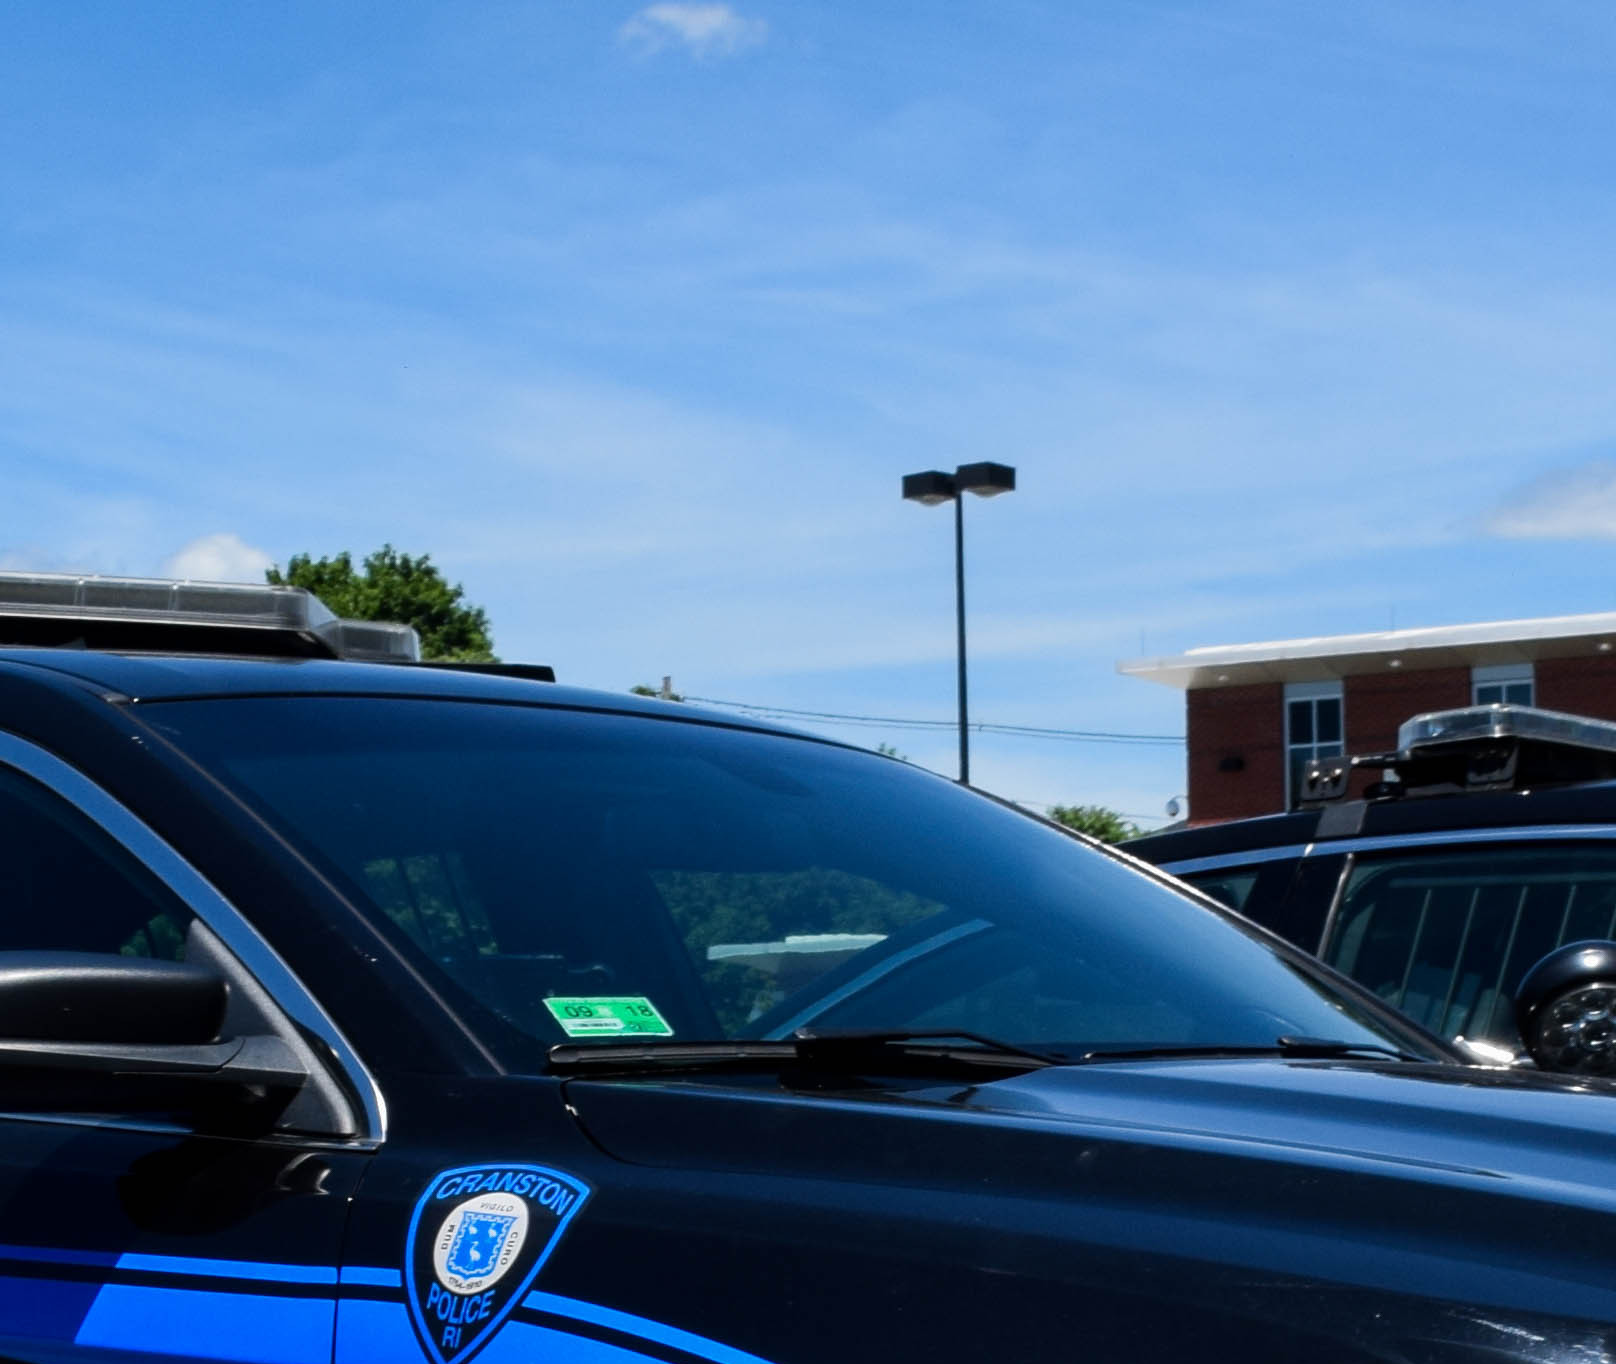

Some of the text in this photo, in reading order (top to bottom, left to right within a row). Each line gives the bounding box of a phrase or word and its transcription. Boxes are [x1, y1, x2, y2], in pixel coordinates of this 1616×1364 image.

[563, 1004, 654, 1018] 09 18
[436, 1171, 575, 1216] CRANSTON
[440, 1223, 457, 1251] DUM
[500, 1231, 519, 1266] CURO
[426, 1281, 496, 1325] POLICE
[441, 1326, 463, 1349] RI
